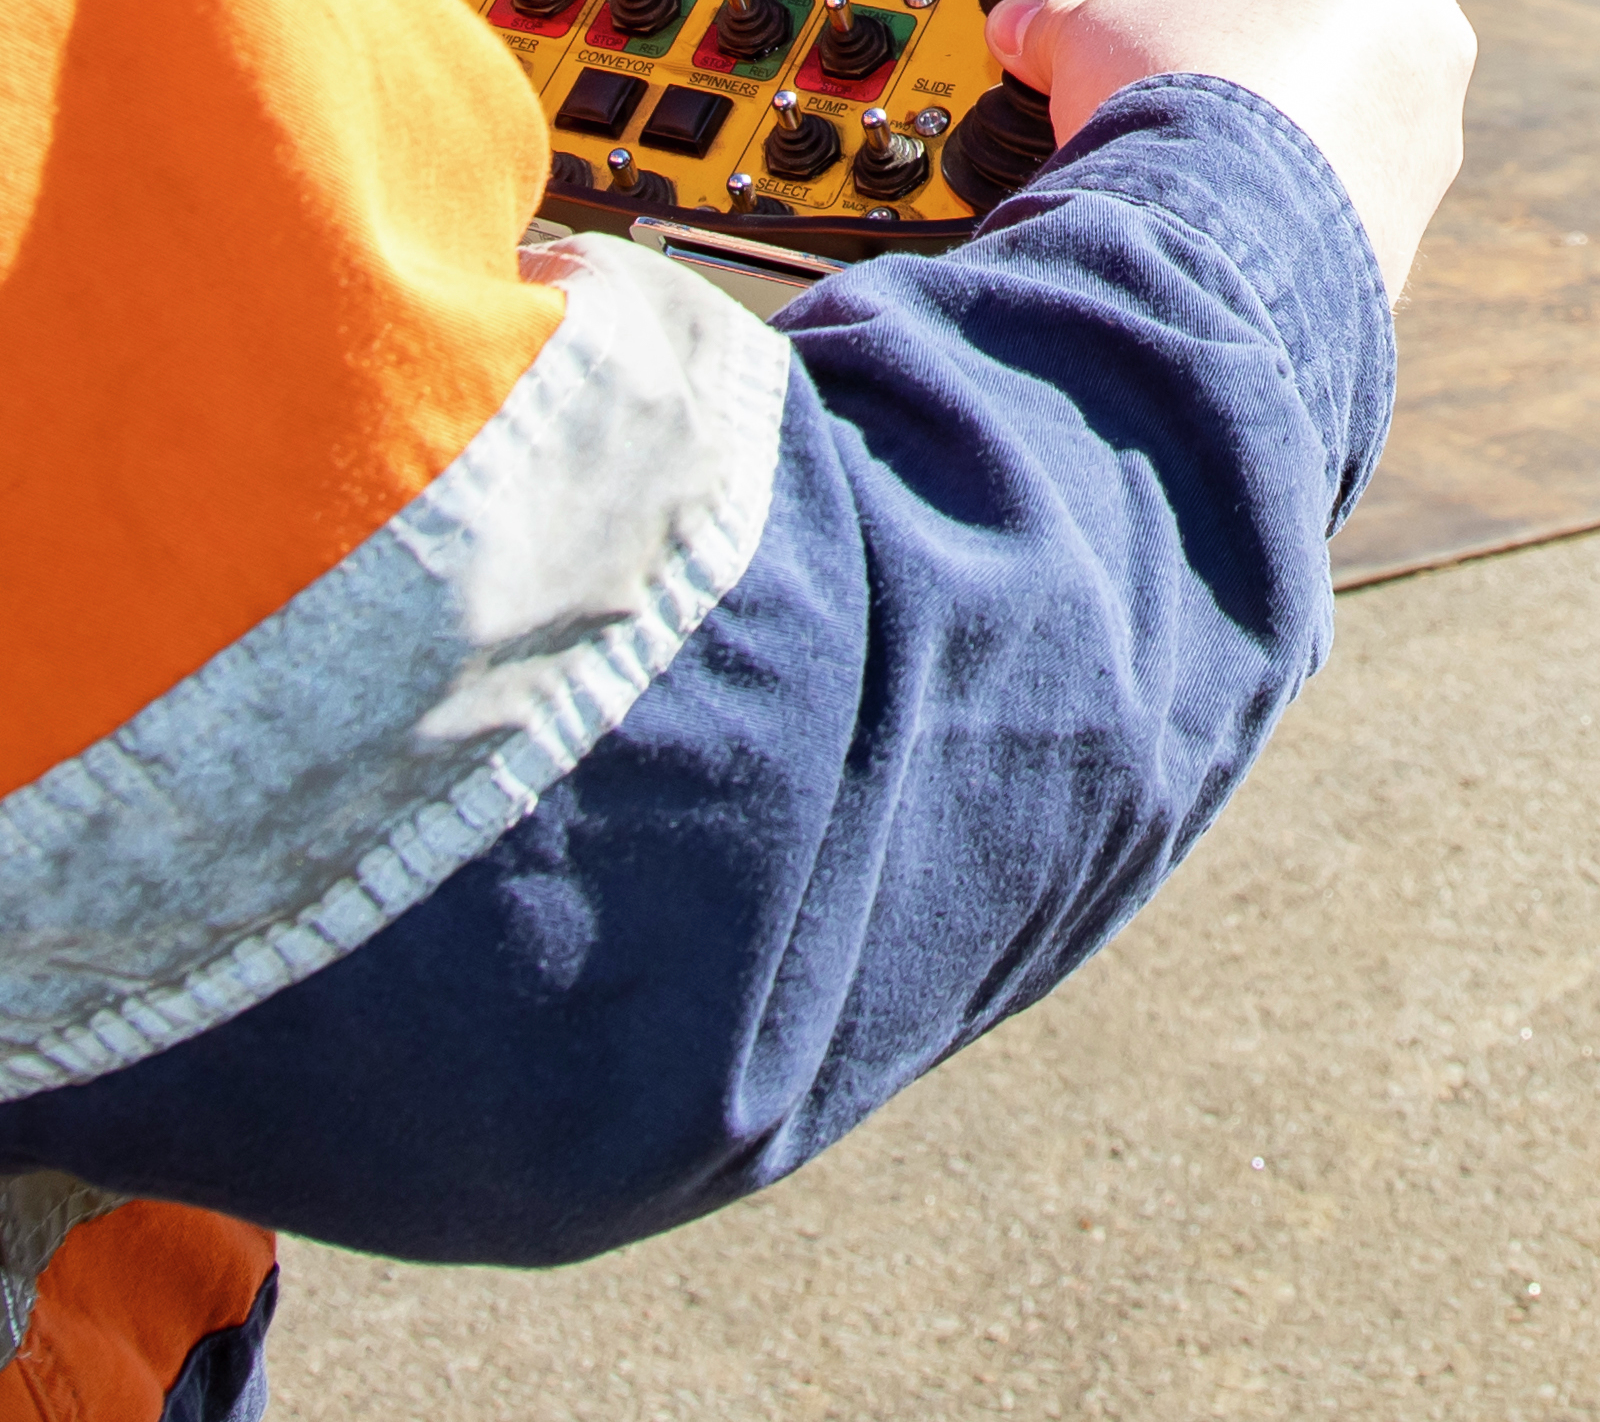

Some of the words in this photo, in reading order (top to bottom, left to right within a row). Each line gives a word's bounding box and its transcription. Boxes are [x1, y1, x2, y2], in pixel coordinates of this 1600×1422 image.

[639, 42, 664, 55] REV
[578, 49, 654, 74] CONVEYOR
[749, 65, 774, 79] REV
[689, 72, 760, 96] SPINNERS
[914, 78, 956, 95] SLIDE
[806, 97, 848, 115] PUMP
[755, 177, 812, 200] SELECT
